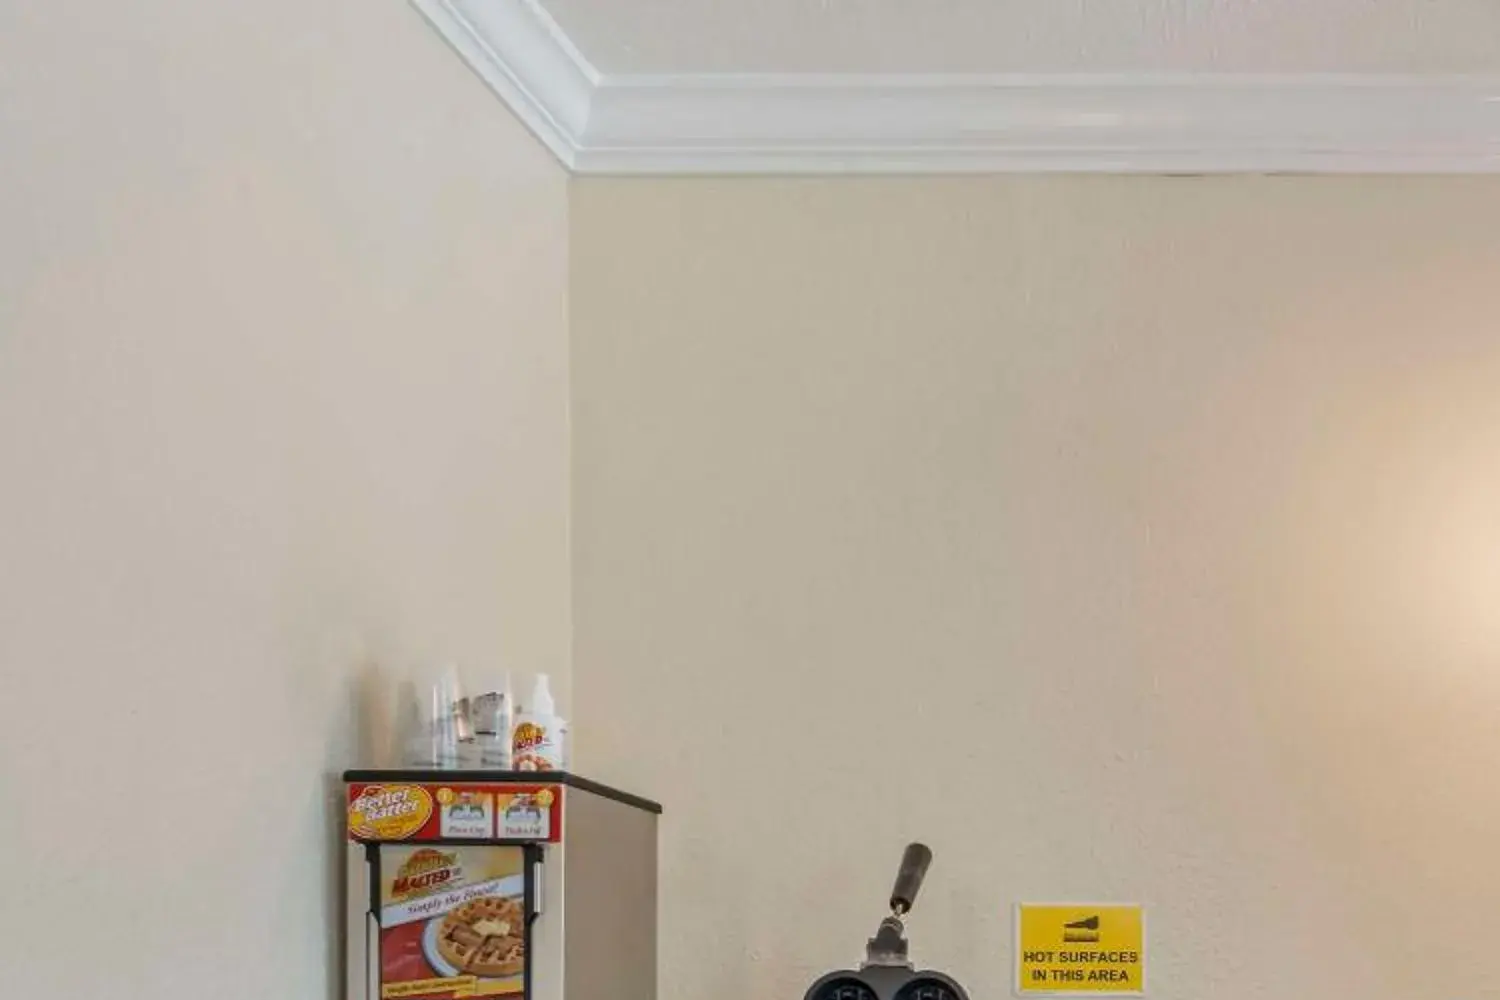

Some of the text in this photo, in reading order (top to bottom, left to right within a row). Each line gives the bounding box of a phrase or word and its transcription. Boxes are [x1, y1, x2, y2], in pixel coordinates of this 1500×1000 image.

[1023, 951, 1138, 963] HOT SURFACES
[1032, 969, 1129, 981] IN THIS AREA
